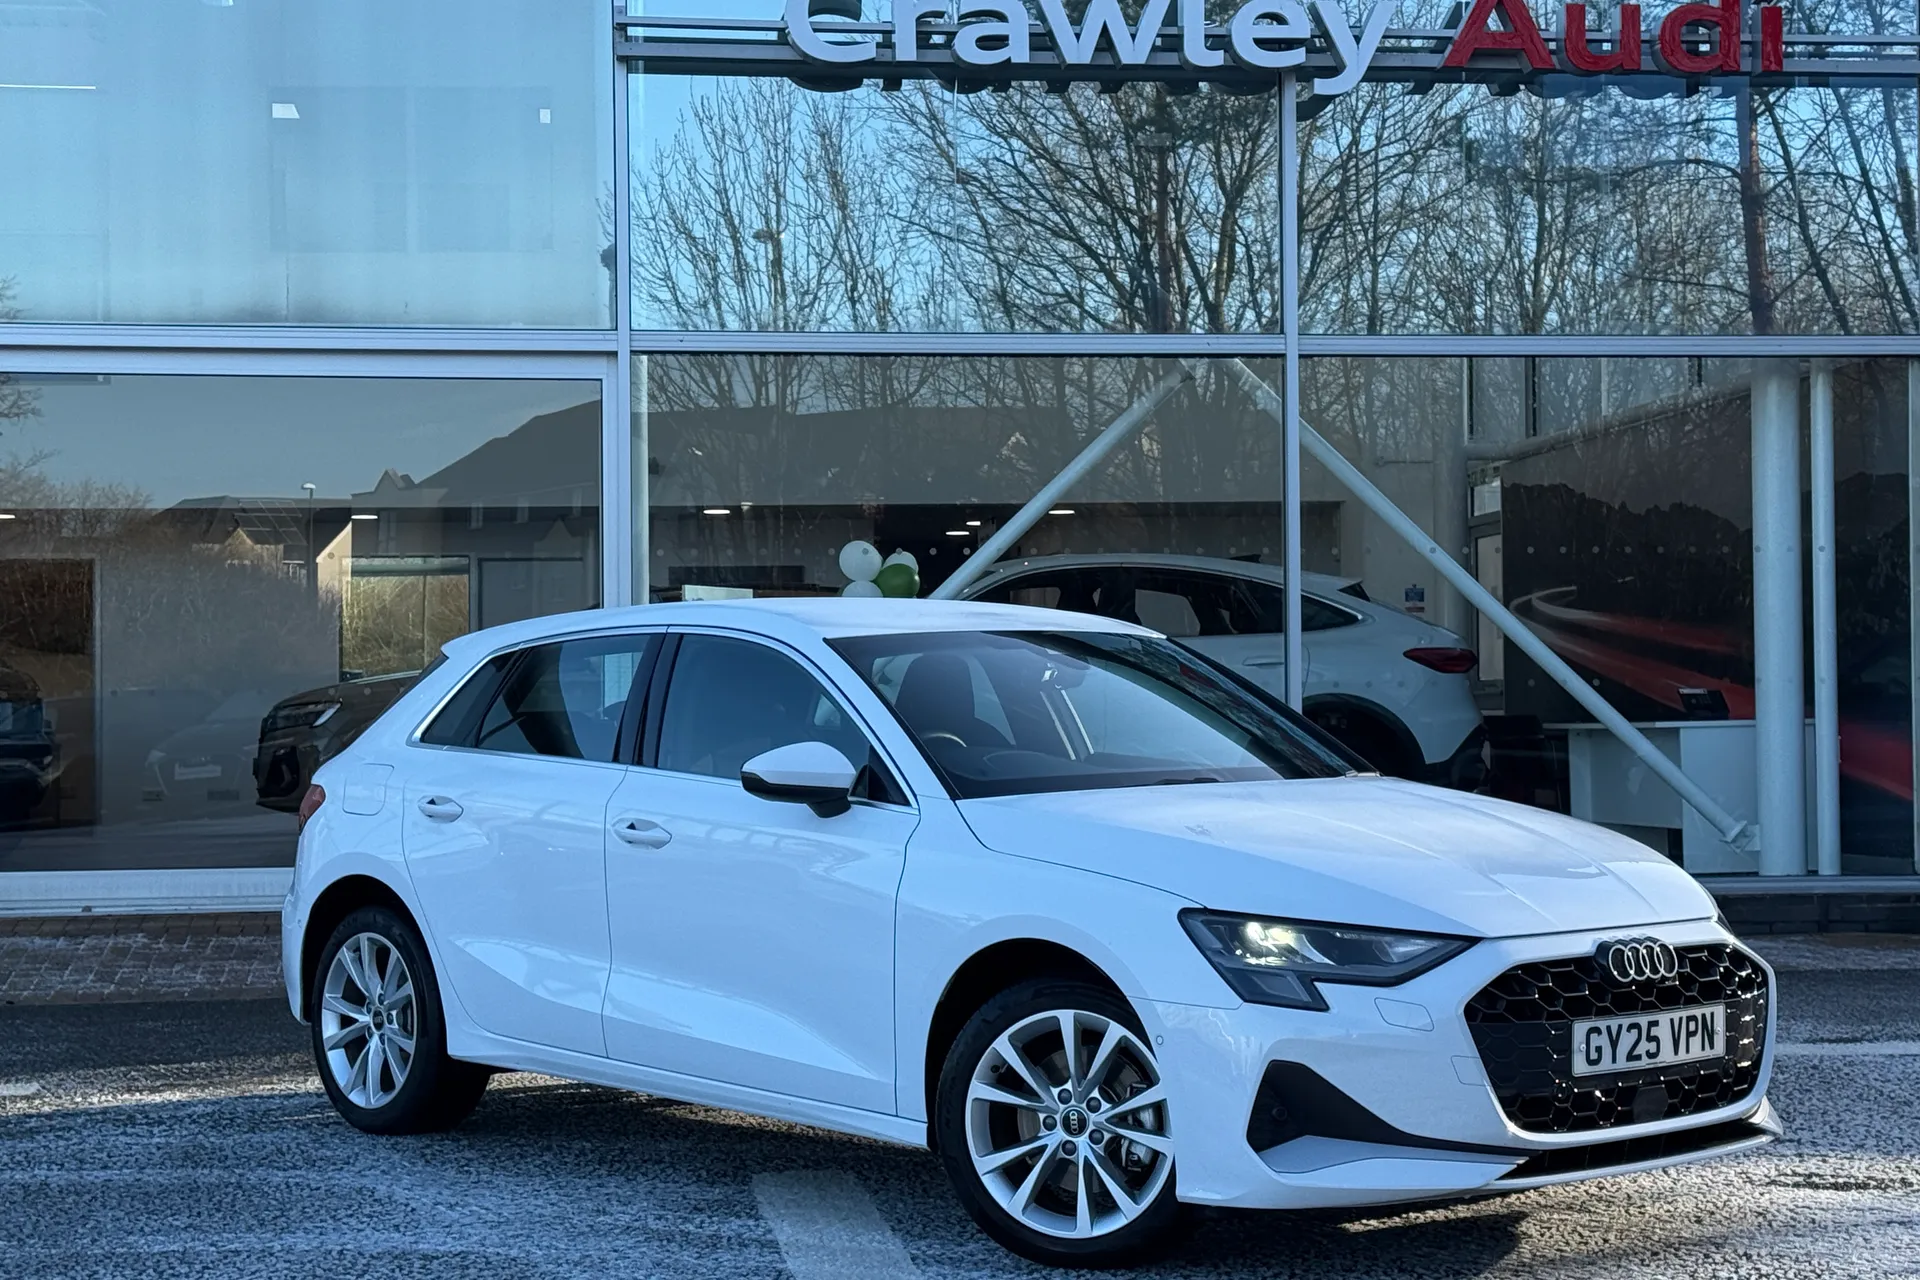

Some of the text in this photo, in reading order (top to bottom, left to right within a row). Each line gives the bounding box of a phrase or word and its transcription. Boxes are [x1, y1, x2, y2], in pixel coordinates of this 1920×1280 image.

[784, 0, 1784, 96] Crawley Audi
[1585, 1011, 1715, 1067] GY25 VPN
